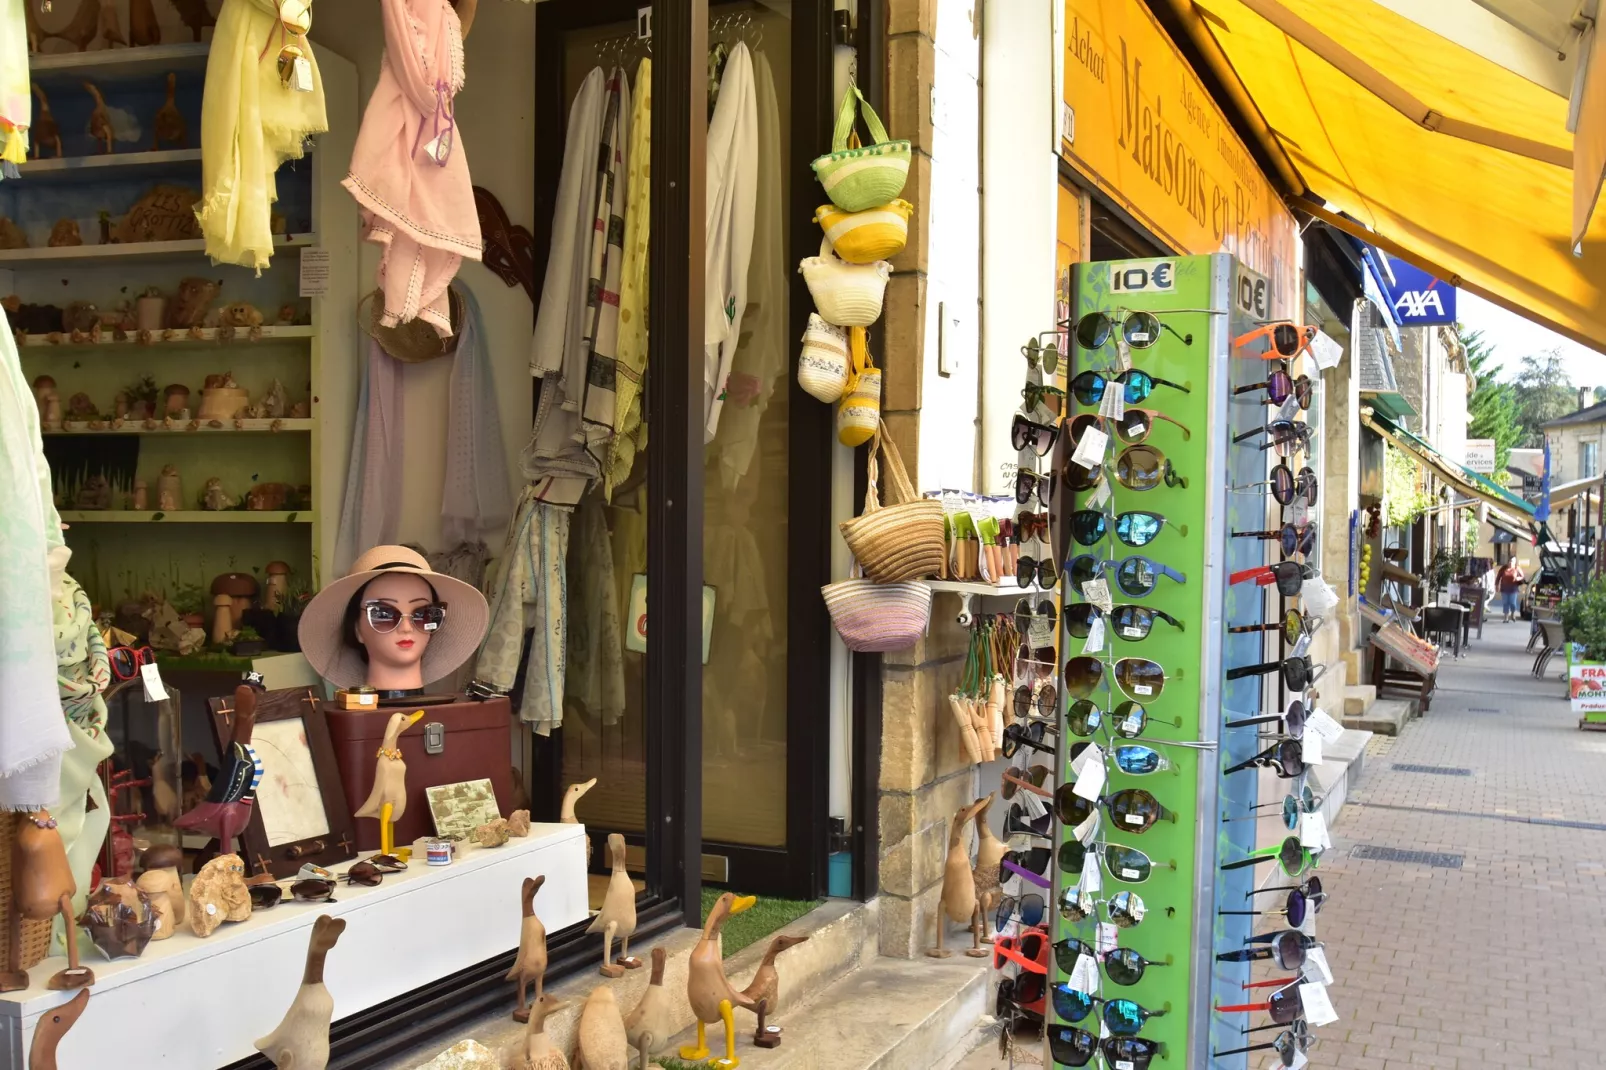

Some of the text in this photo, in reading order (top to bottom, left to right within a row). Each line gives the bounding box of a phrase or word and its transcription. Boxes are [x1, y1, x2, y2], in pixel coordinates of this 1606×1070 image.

[1067, 16, 1106, 84] Achat
[1117, 35, 1207, 229] Maisons
[1212, 184, 1231, 253] en
[1113, 262, 1172, 290] 10€
[1393, 290, 1445, 317] AXA
